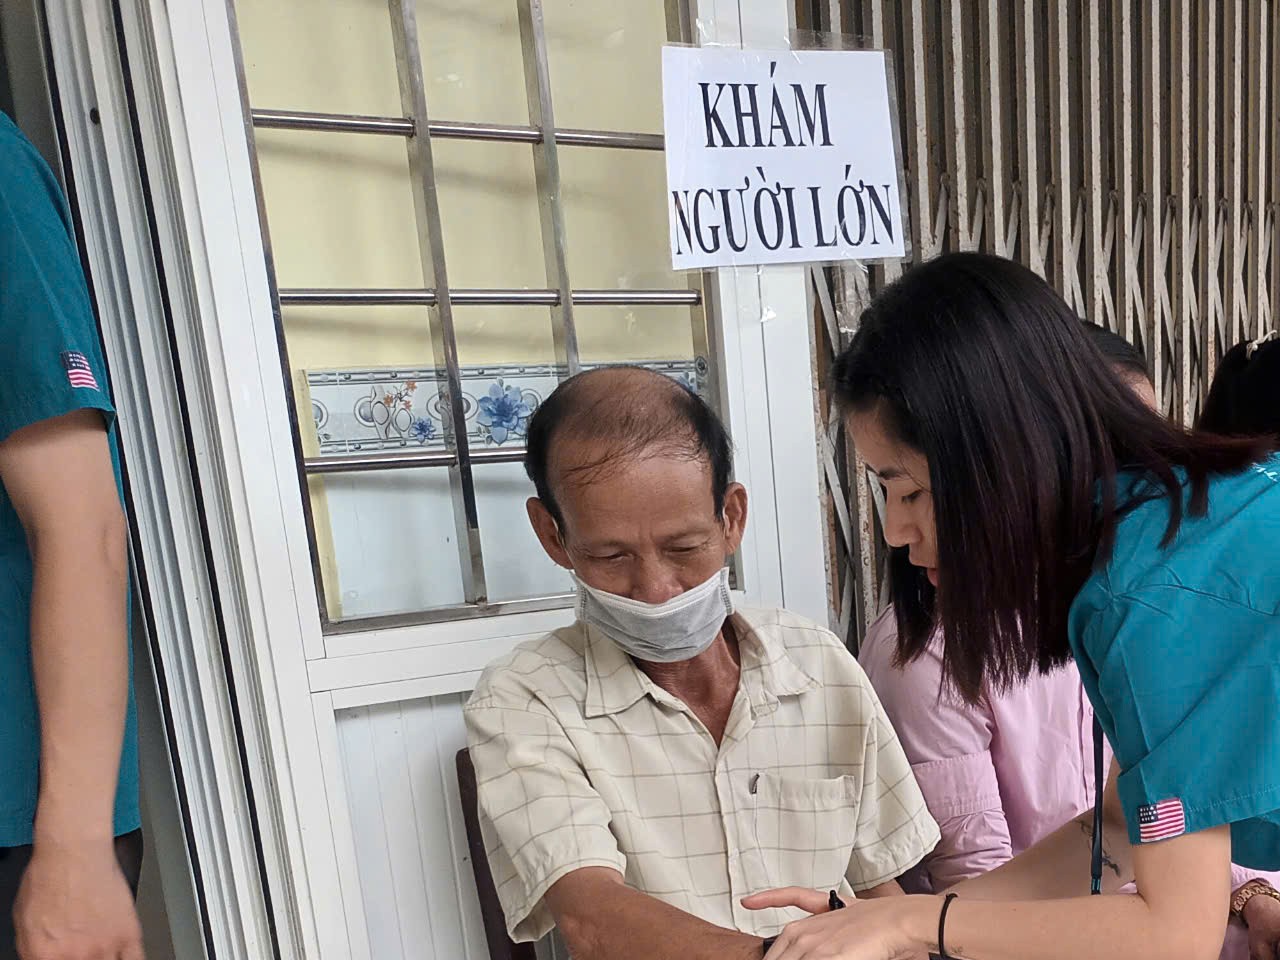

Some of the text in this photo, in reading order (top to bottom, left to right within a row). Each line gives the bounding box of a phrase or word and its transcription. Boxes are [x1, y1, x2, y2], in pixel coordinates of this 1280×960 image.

[697, 61, 835, 148] KHÁM
[671, 164, 895, 255] NGƯỜI LỚN
